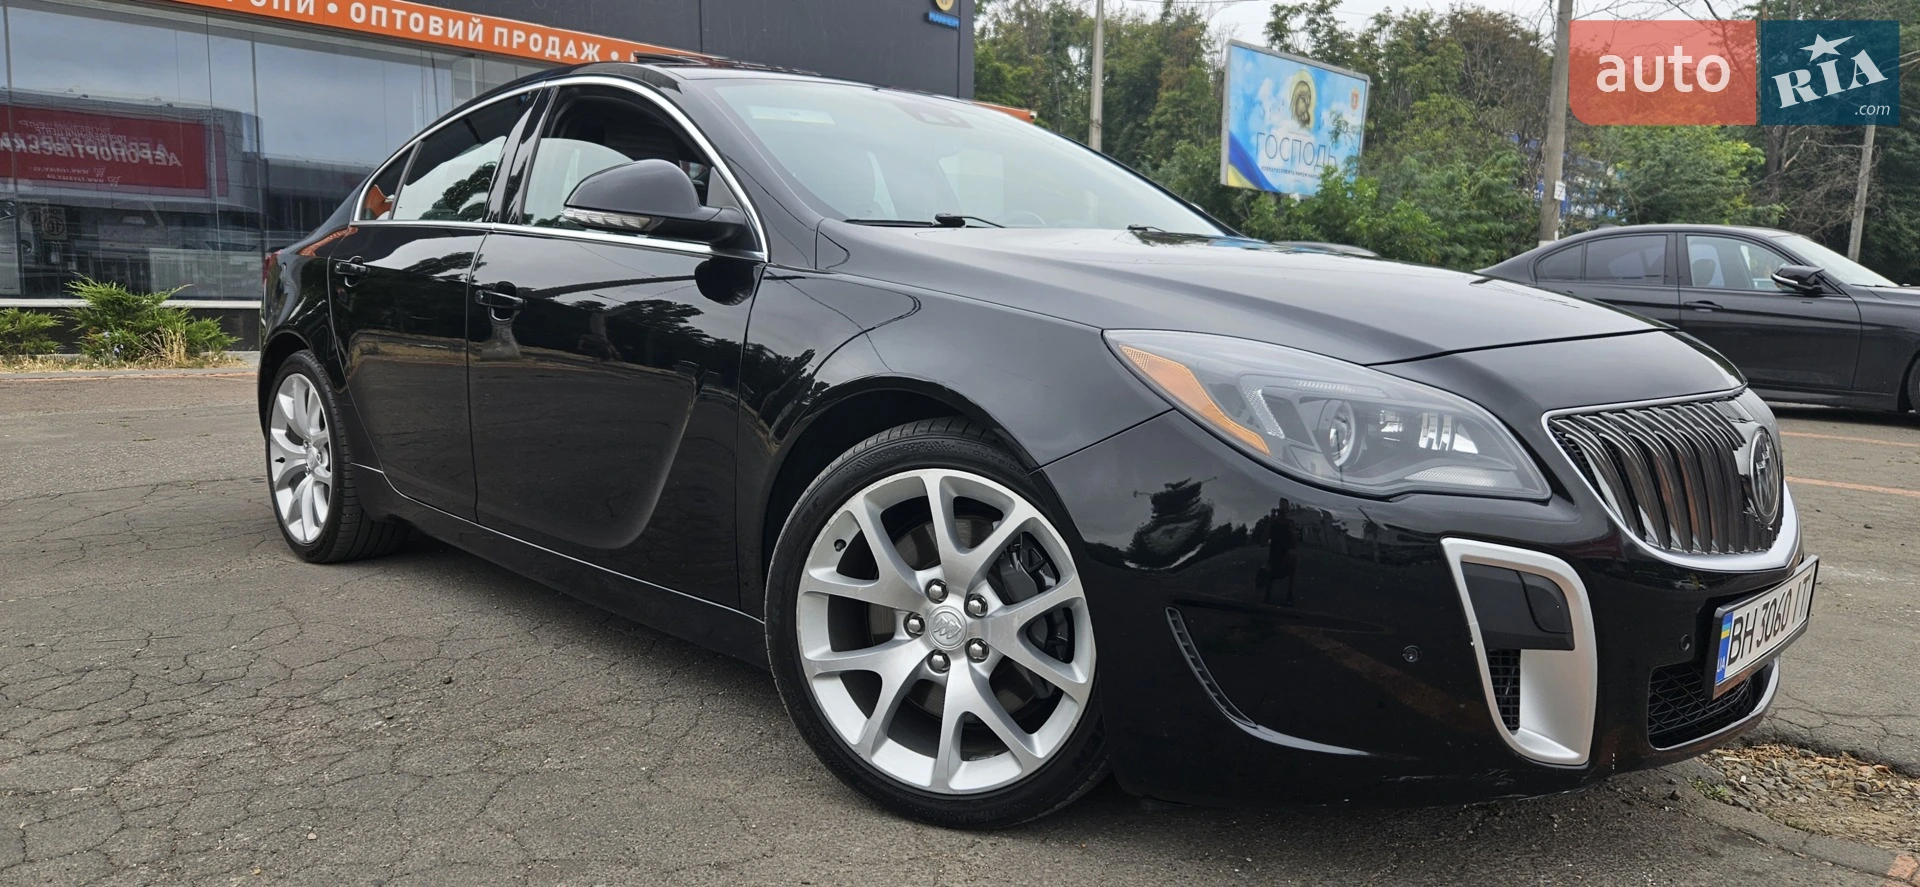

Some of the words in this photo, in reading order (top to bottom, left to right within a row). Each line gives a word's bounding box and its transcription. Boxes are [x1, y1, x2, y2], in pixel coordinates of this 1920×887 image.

[350, 2, 484, 43] ОПТОВИЙ
[493, 26, 601, 61] ПРОДАЖ
[1255, 132, 1337, 171] ГОСПОДЬ
[1727, 607, 1758, 666] BH
[1756, 588, 1792, 648] 3060
